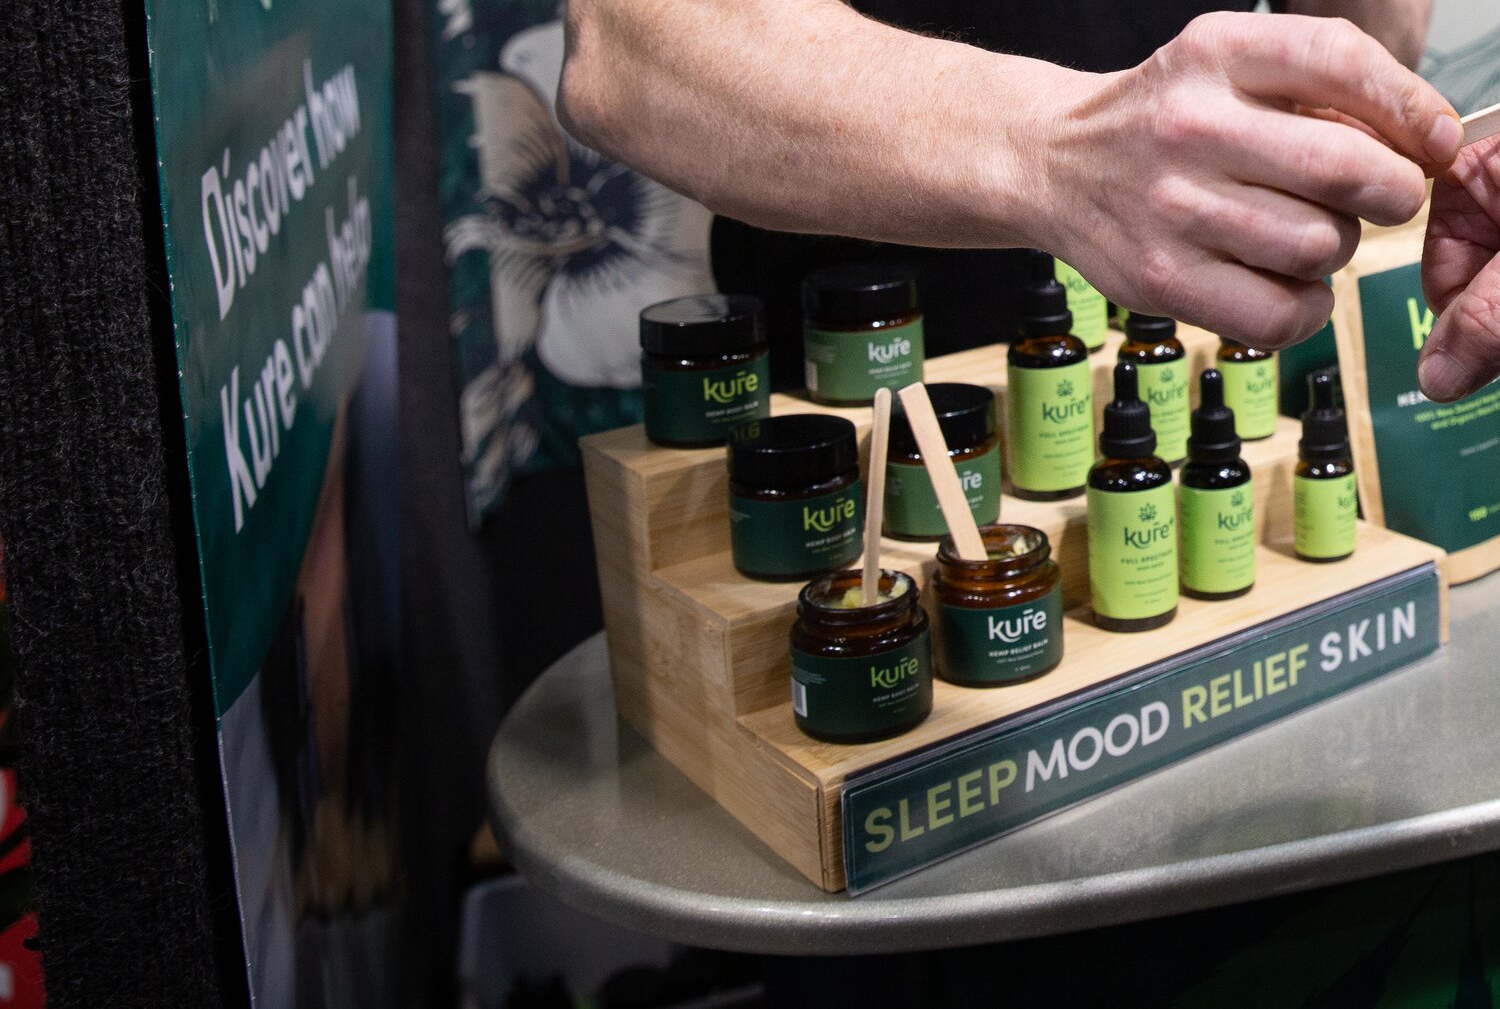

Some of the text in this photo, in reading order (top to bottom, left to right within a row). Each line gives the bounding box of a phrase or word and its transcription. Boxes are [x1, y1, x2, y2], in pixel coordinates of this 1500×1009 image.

[201, 57, 361, 321] Discover how
[221, 175, 373, 535] Kure can help
[864, 759, 1018, 854] SLEEP
[1025, 701, 1170, 792] MOOD
[1183, 643, 1309, 730] RELIEF
[1320, 601, 1416, 672] SKIN
